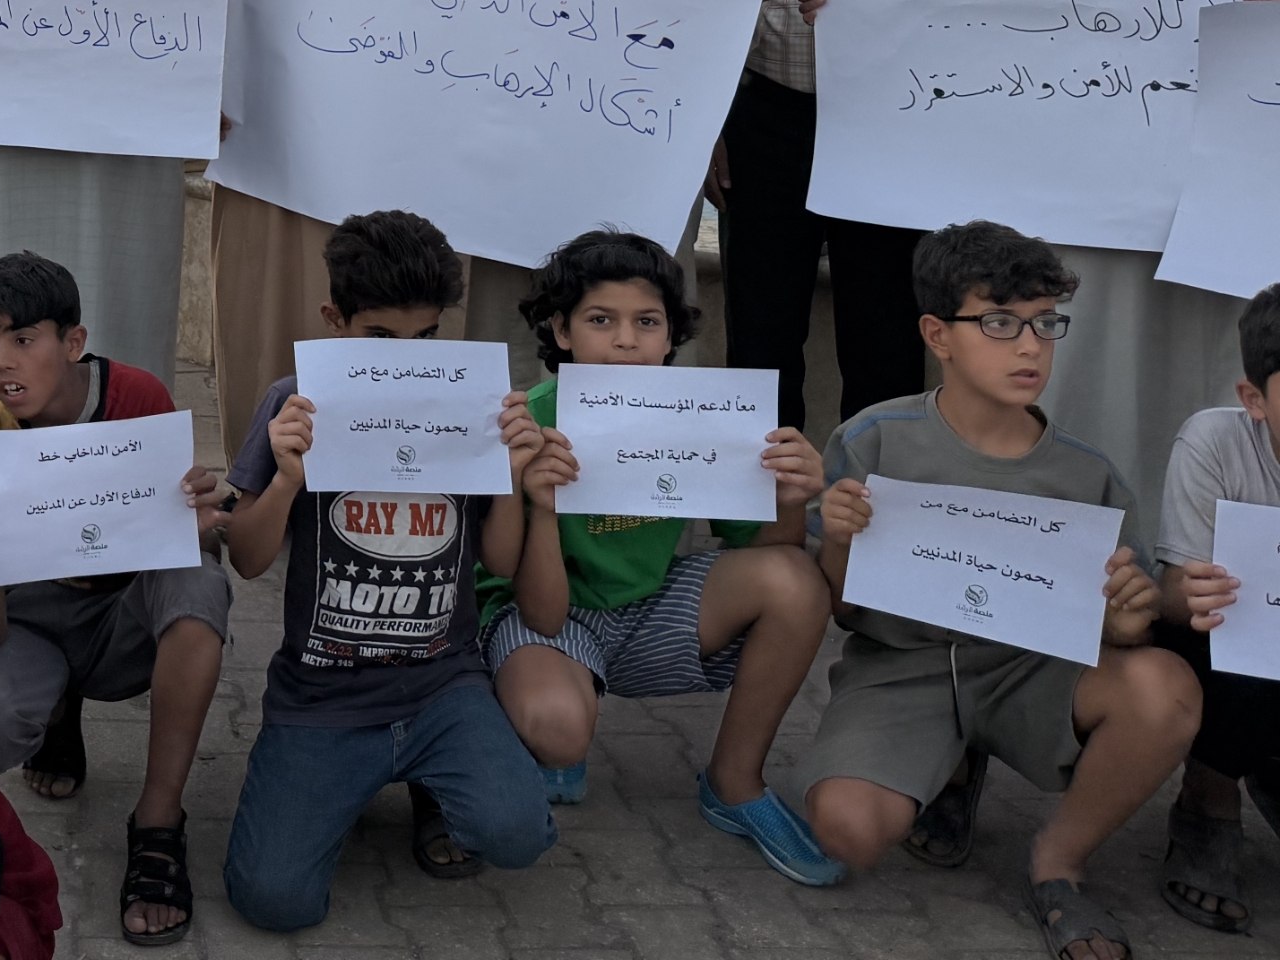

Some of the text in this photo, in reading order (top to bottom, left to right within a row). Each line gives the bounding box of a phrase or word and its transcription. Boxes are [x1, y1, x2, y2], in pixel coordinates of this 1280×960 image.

[22, 7, 54, 36] عن
[898, 63, 1055, 112] والاستقرار
[1059, 60, 1133, 98] للأمن
[348, 365, 467, 383] كل التضامن مع من
[579, 392, 624, 407] الأمنية
[627, 396, 694, 413] المؤسسات
[698, 400, 731, 414] لدعم
[350, 417, 468, 436] يحمون حياة المدنيين
[38, 439, 142, 463] الأمن الداخلي خط
[617, 448, 717, 465] في حماية المجتمع
[26, 487, 156, 515] الدفاع الأول عن المدنيين
[343, 499, 448, 537] RAY M7
[920, 498, 1066, 533] كل التضامن مع من
[911, 543, 1054, 589] يحمون حياة المدنيين
[319, 577, 421, 615] MOTO
[320, 611, 372, 632] QUALITY
